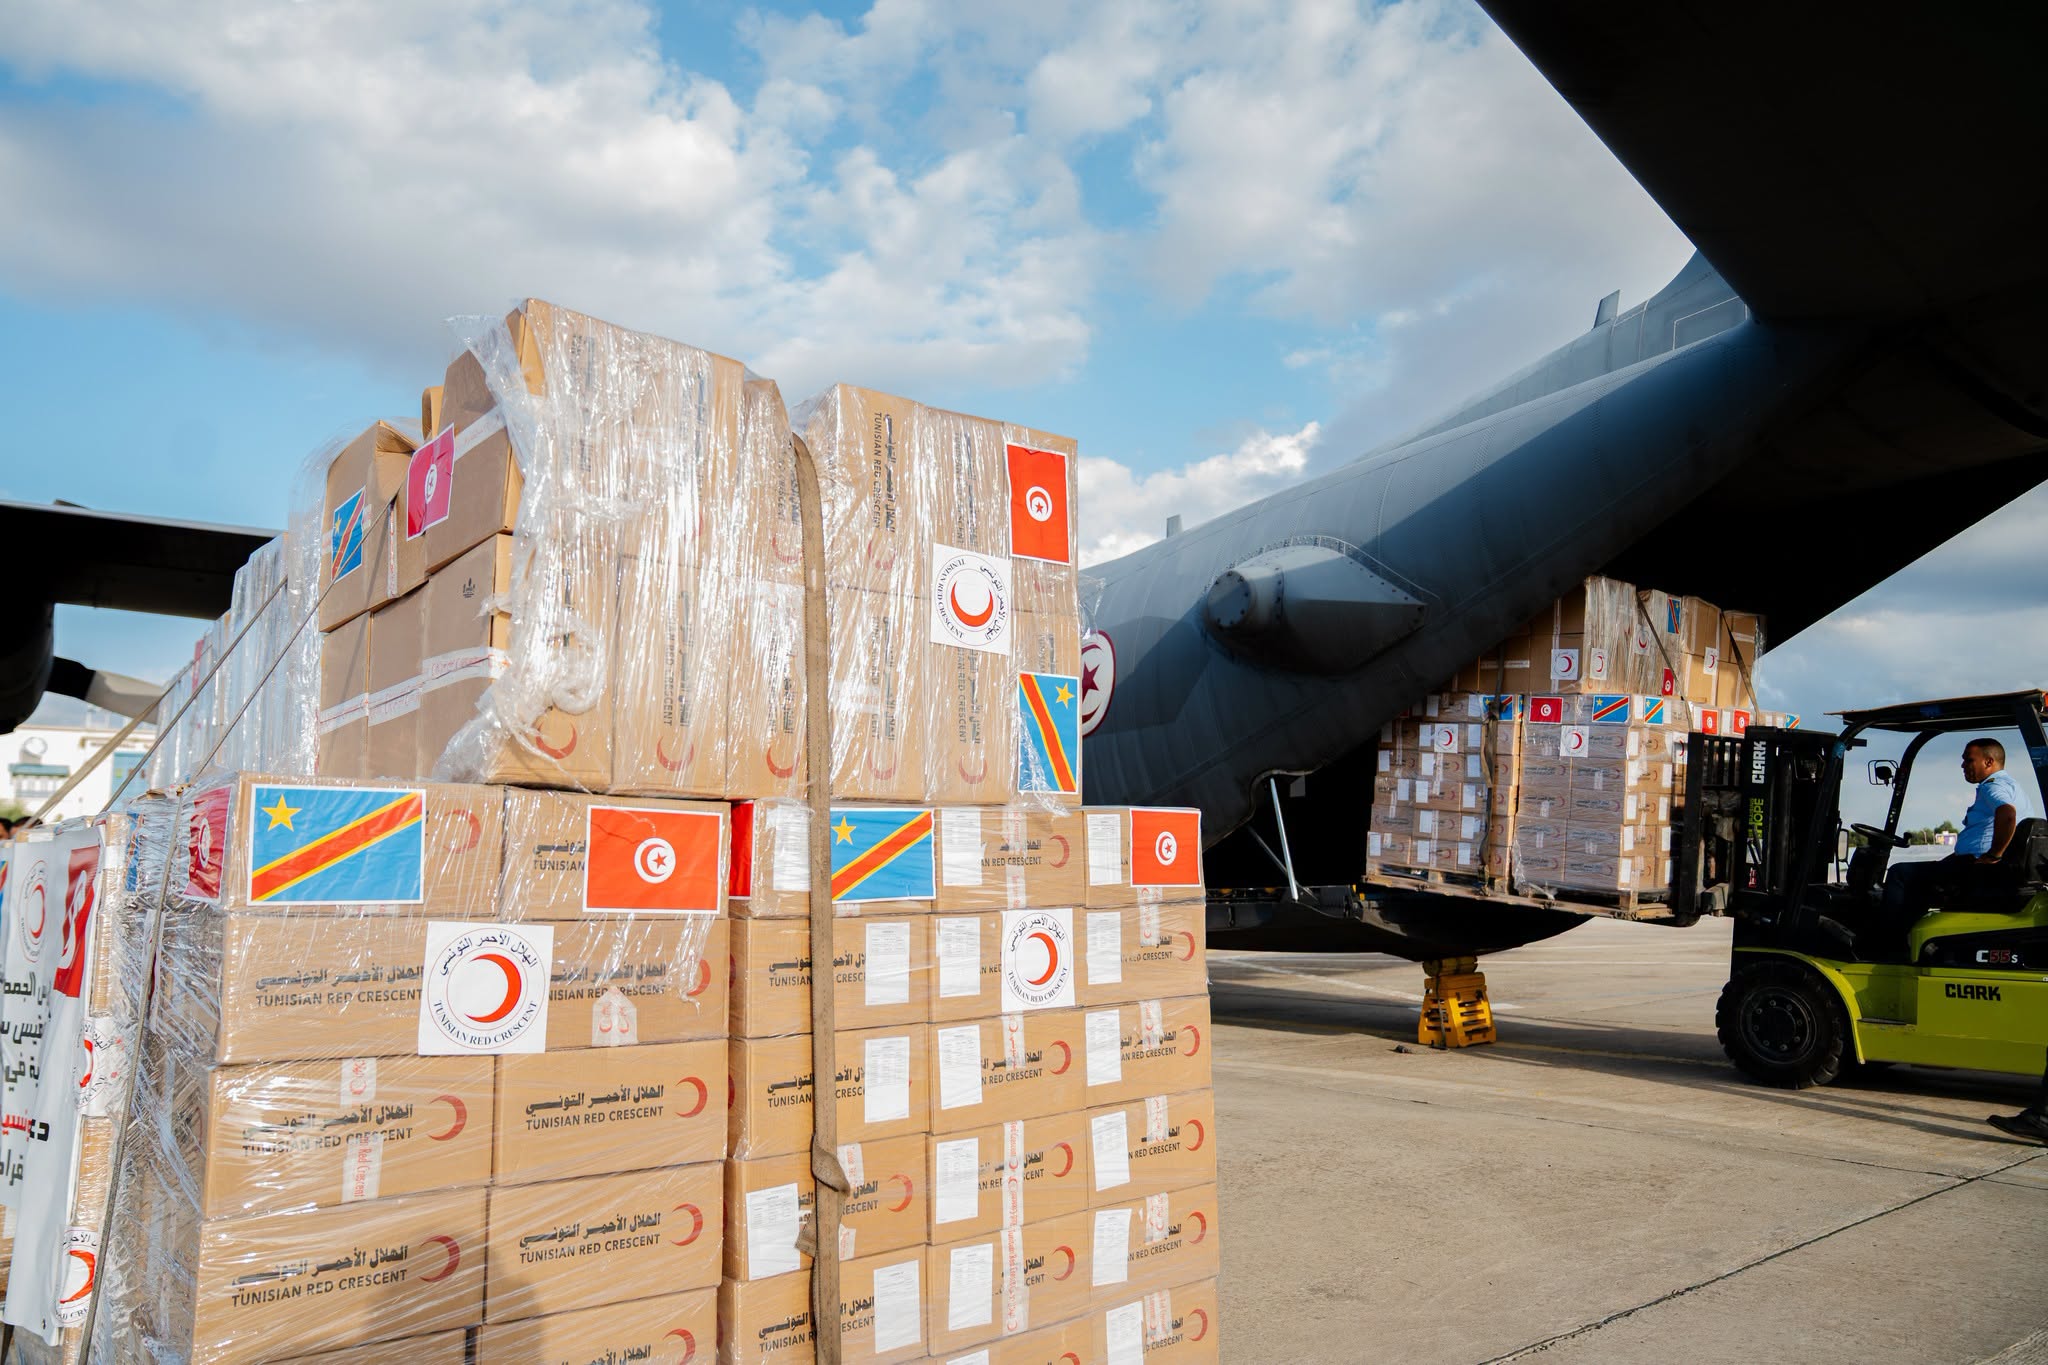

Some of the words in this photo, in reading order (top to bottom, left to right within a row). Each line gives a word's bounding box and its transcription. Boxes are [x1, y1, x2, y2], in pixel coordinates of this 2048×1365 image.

[873, 412, 882, 456] TUNISIAN
[940, 558, 966, 581] TUNISIAN
[980, 566, 1003, 591] التونسي
[938, 601, 964, 639] CRESCENT
[985, 619, 1001, 641] الهلال
[957, 672, 967, 692] RED
[958, 695, 967, 744] CRESCENT
[1751, 740, 1767, 785] CLARK
[1749, 797, 1765, 829] HOPE
[533, 858, 585, 872] TUNISIAN
[992, 857, 1005, 867] RED
[1008, 856, 1042, 867] CRESCENT
[477, 930, 511, 948] الأحمر
[1010, 920, 1028, 952] التونسي
[1048, 921, 1065, 941] الهلال
[440, 936, 473, 976] التونسي
[510, 941, 538, 968] الهلال
[1142, 951, 1173, 961] CRESCENT
[769, 975, 812, 988] TUNISIAN
[836, 973, 865, 983] CRESC
[1008, 970, 1029, 1000] TUNISIAN
[1031, 994, 1044, 1002] RED
[1044, 967, 1067, 1000] CRESCENT
[255, 992, 322, 1007] TUNISIAN
[327, 991, 353, 1005] RED
[357, 988, 422, 1003] CRESCENT
[549, 988, 584, 1002] NISIAN
[617, 984, 667, 997] RESCENT
[1945, 983, 2001, 1001] CLARK
[433, 999, 468, 1041] TUNISIAN
[469, 1034, 492, 1046] RED
[493, 1000, 538, 1044] CRESCENT
[1131, 1051, 1145, 1060] RED
[1146, 1046, 1177, 1058] CRESCENT
[989, 1074, 1004, 1085] RED
[1006, 1068, 1043, 1082] CRESCENT
[525, 1092, 585, 1118] التونسي
[587, 1084, 631, 1109] الأحمر
[632, 1085, 664, 1103] الهلال
[768, 1093, 812, 1108] TUNISIAN
[835, 1087, 866, 1099] CRESC
[375, 1103, 413, 1125] الهلال
[526, 1114, 580, 1131] TUNISIAN
[584, 1110, 605, 1124] RED
[609, 1105, 664, 1122] CRESCENT
[314, 1135, 341, 1150] RED
[1134, 1147, 1148, 1159] RED
[1149, 1142, 1181, 1156] CRESCENT
[841, 1199, 878, 1216] RESCENT
[583, 1213, 627, 1240] الأحمر
[629, 1212, 661, 1232] الهلال
[519, 1222, 580, 1249] التونسي
[369, 1245, 408, 1268] الهلال
[519, 1246, 575, 1264] TUNISIAN
[579, 1241, 601, 1255] RED
[605, 1233, 661, 1252] CRESCENT
[1136, 1248, 1149, 1260] RED
[1150, 1239, 1182, 1256] CRESCENT
[311, 1247, 366, 1277] الأحمر
[231, 1285, 301, 1308] TUNISIAN
[306, 1280, 333, 1296] RED
[338, 1269, 408, 1290] CRESCENT
[1025, 1273, 1045, 1287] CENT
[758, 1312, 809, 1340] التونسي
[759, 1333, 806, 1353] TUNISIAN
[841, 1315, 875, 1333] ESCENT
[1149, 1333, 1184, 1351] CRESCENT
